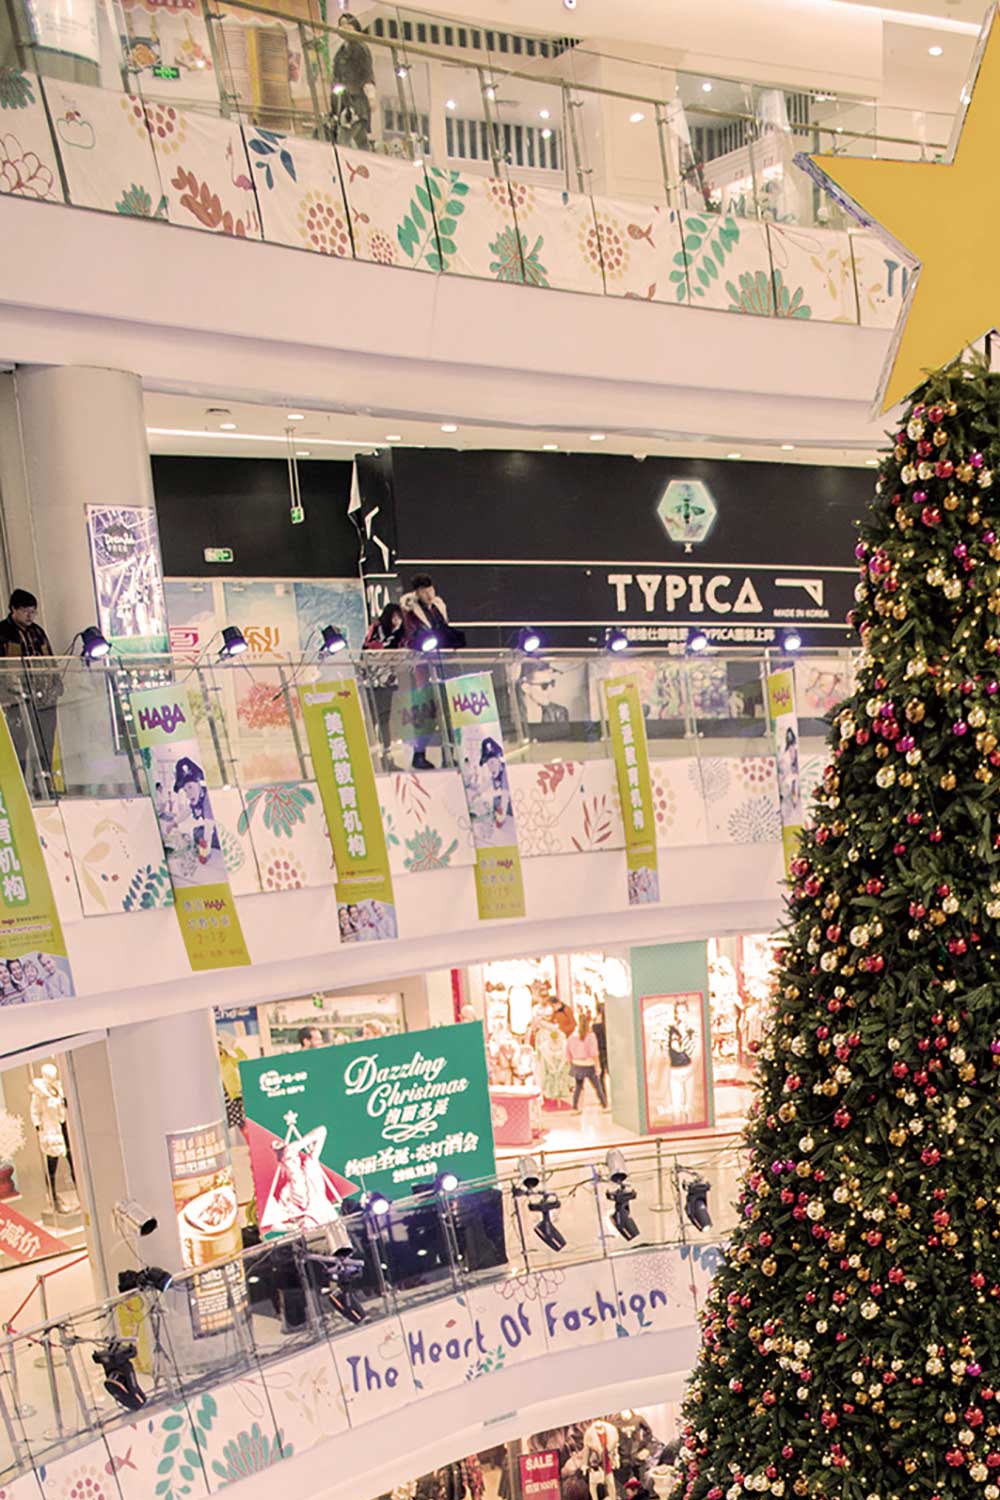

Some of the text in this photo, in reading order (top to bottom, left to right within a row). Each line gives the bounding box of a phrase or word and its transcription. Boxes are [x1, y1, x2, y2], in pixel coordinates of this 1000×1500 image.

[608, 574, 764, 613] TYPICA
[138, 702, 186, 734] HABA
[453, 693, 490, 716] HABA
[344, 1051, 448, 1095] Dazzling
[366, 1077, 469, 1118] Christmas
[346, 1289, 668, 1393] The Heart Of Fashion
[525, 1453, 554, 1471] SALE
